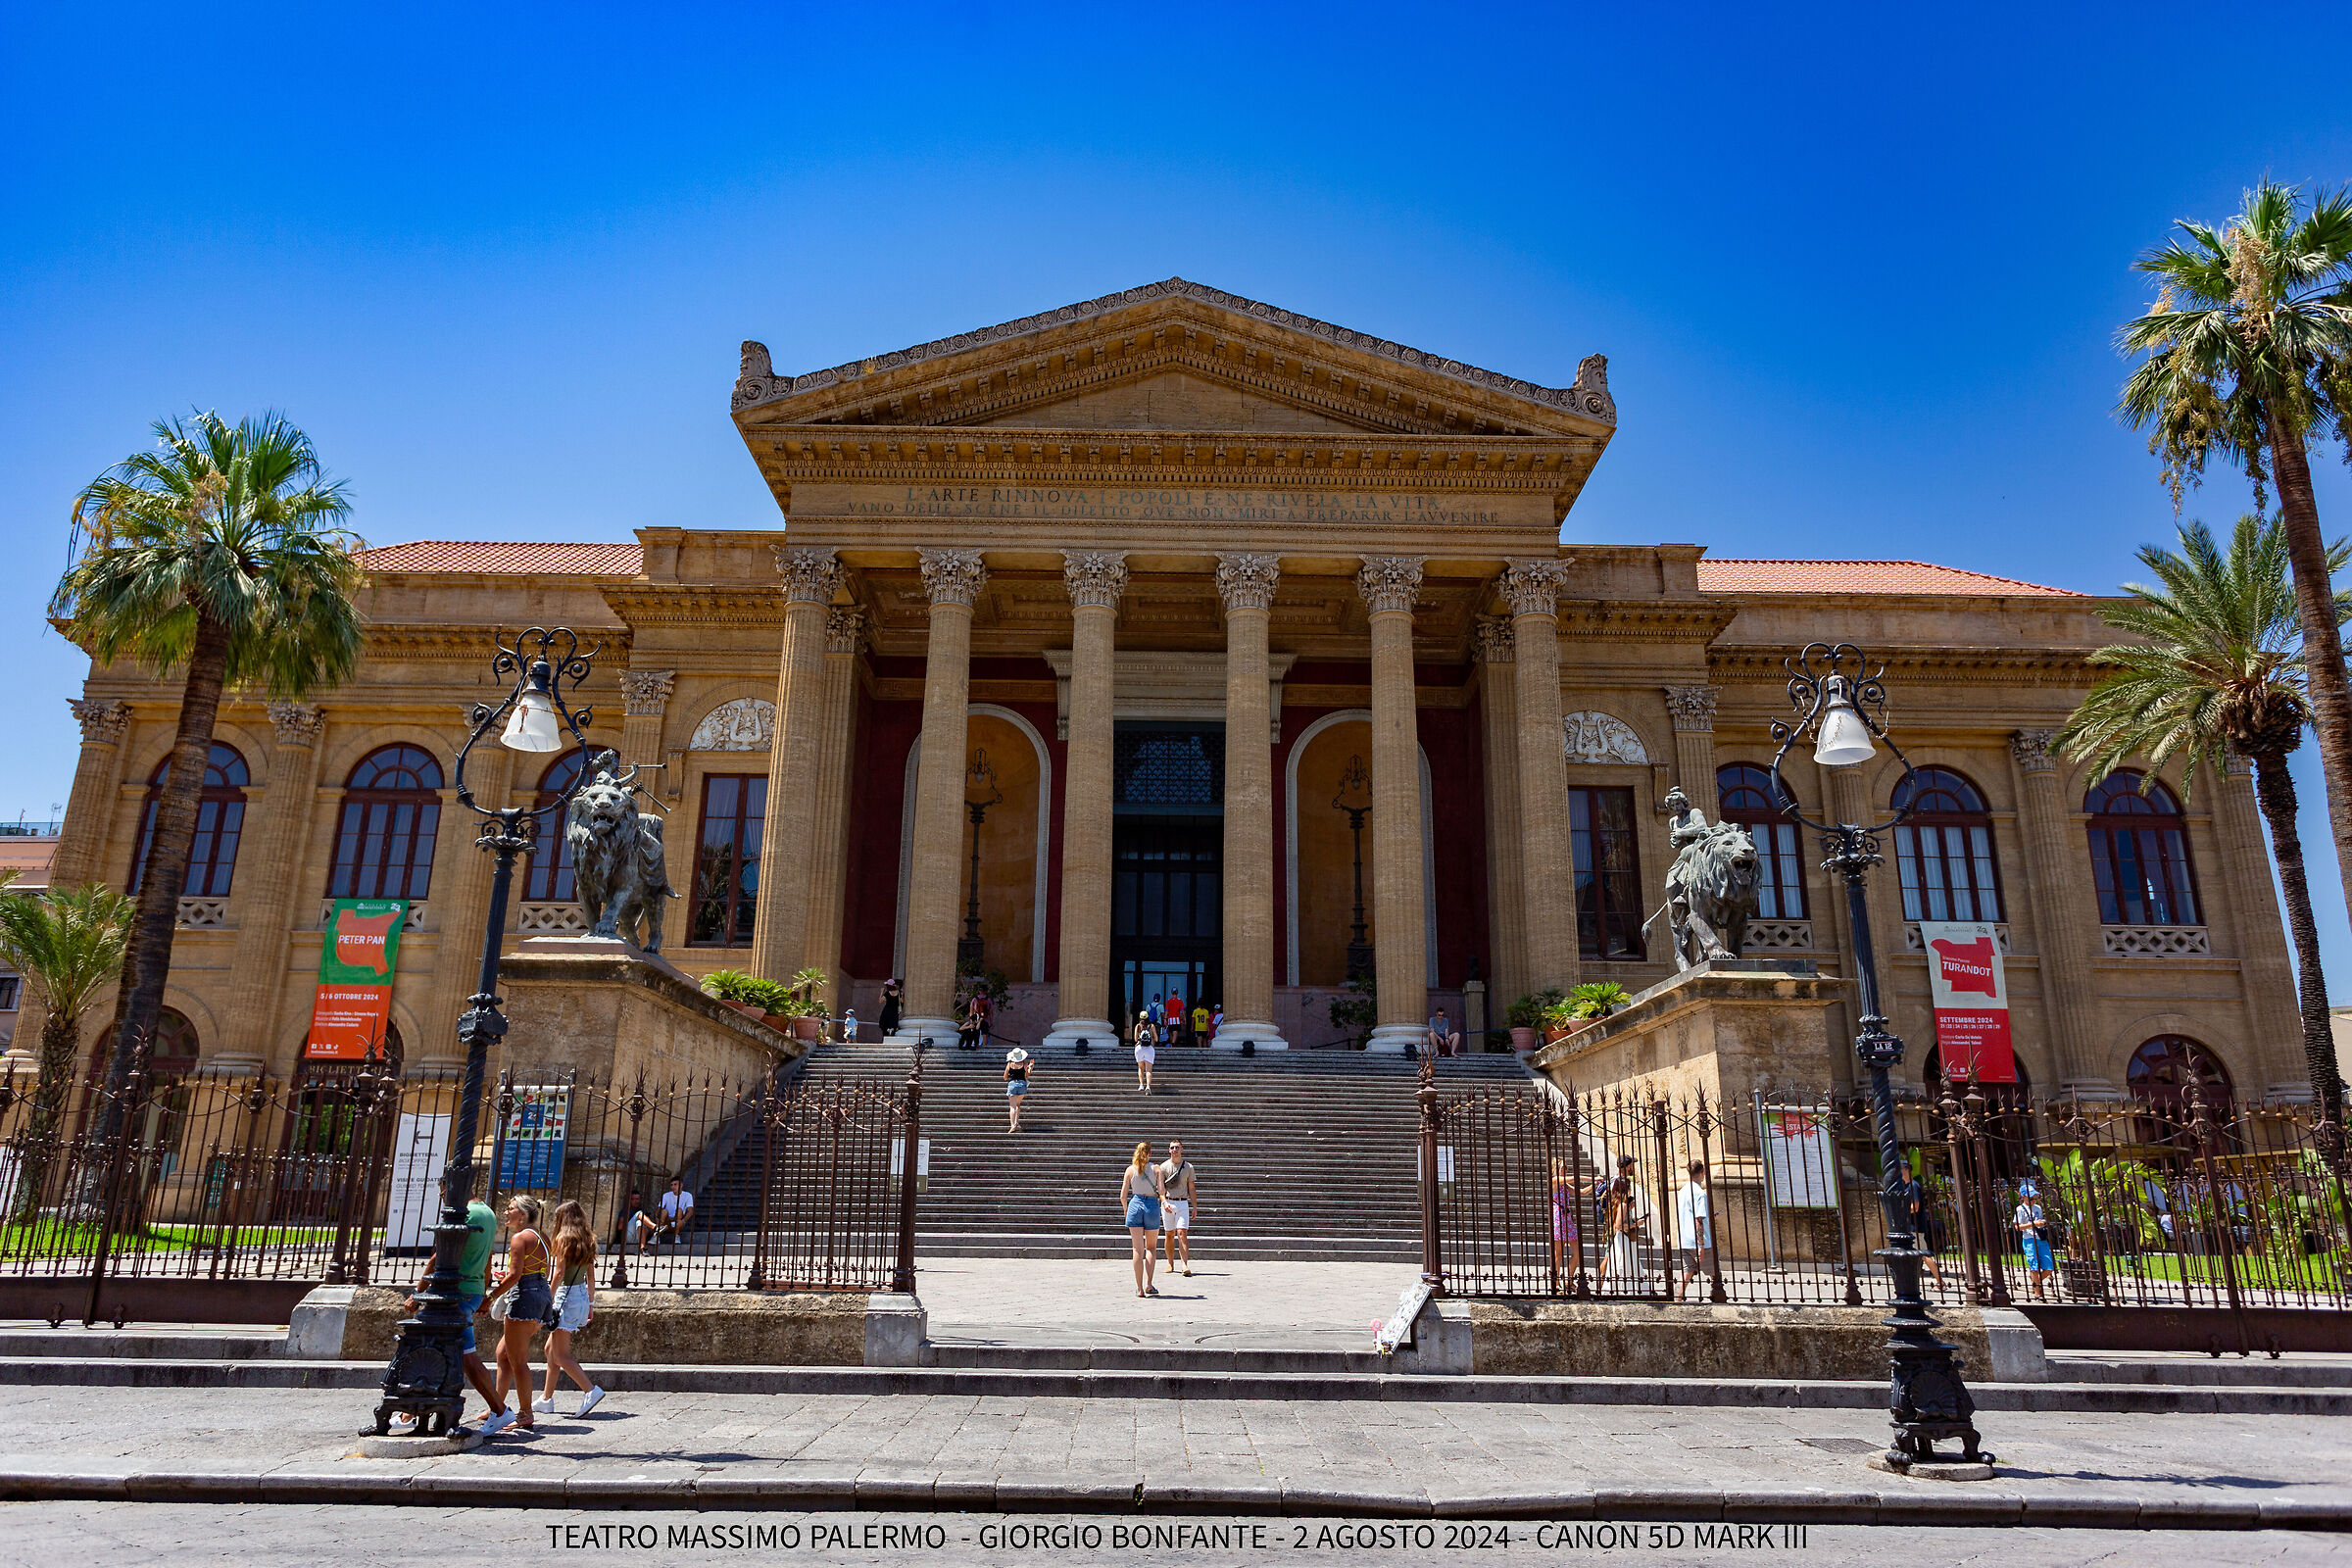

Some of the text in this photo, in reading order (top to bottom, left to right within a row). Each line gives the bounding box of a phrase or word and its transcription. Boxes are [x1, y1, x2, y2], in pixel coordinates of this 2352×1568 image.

[907, 487, 980, 503] L'ARTE
[992, 488, 1089, 504] RINNOVA
[1118, 491, 1192, 506] POPOLI
[1204, 492, 1214, 505] E
[1227, 492, 1254, 507] NE
[1355, 494, 1379, 509] LA
[1389, 495, 1440, 511] VITA
[849, 501, 894, 514] VANO
[964, 503, 1021, 515] SCENE
[1061, 505, 1130, 517] DILETTO
[1187, 506, 1224, 519] NON
[1239, 507, 1276, 519] MIRI
[1305, 509, 1393, 522] PREPARAR
[338, 934, 385, 945] PETER PAN
[1942, 960, 1991, 977] TURANDOT
[1197, 1014, 1205, 1024] 10
